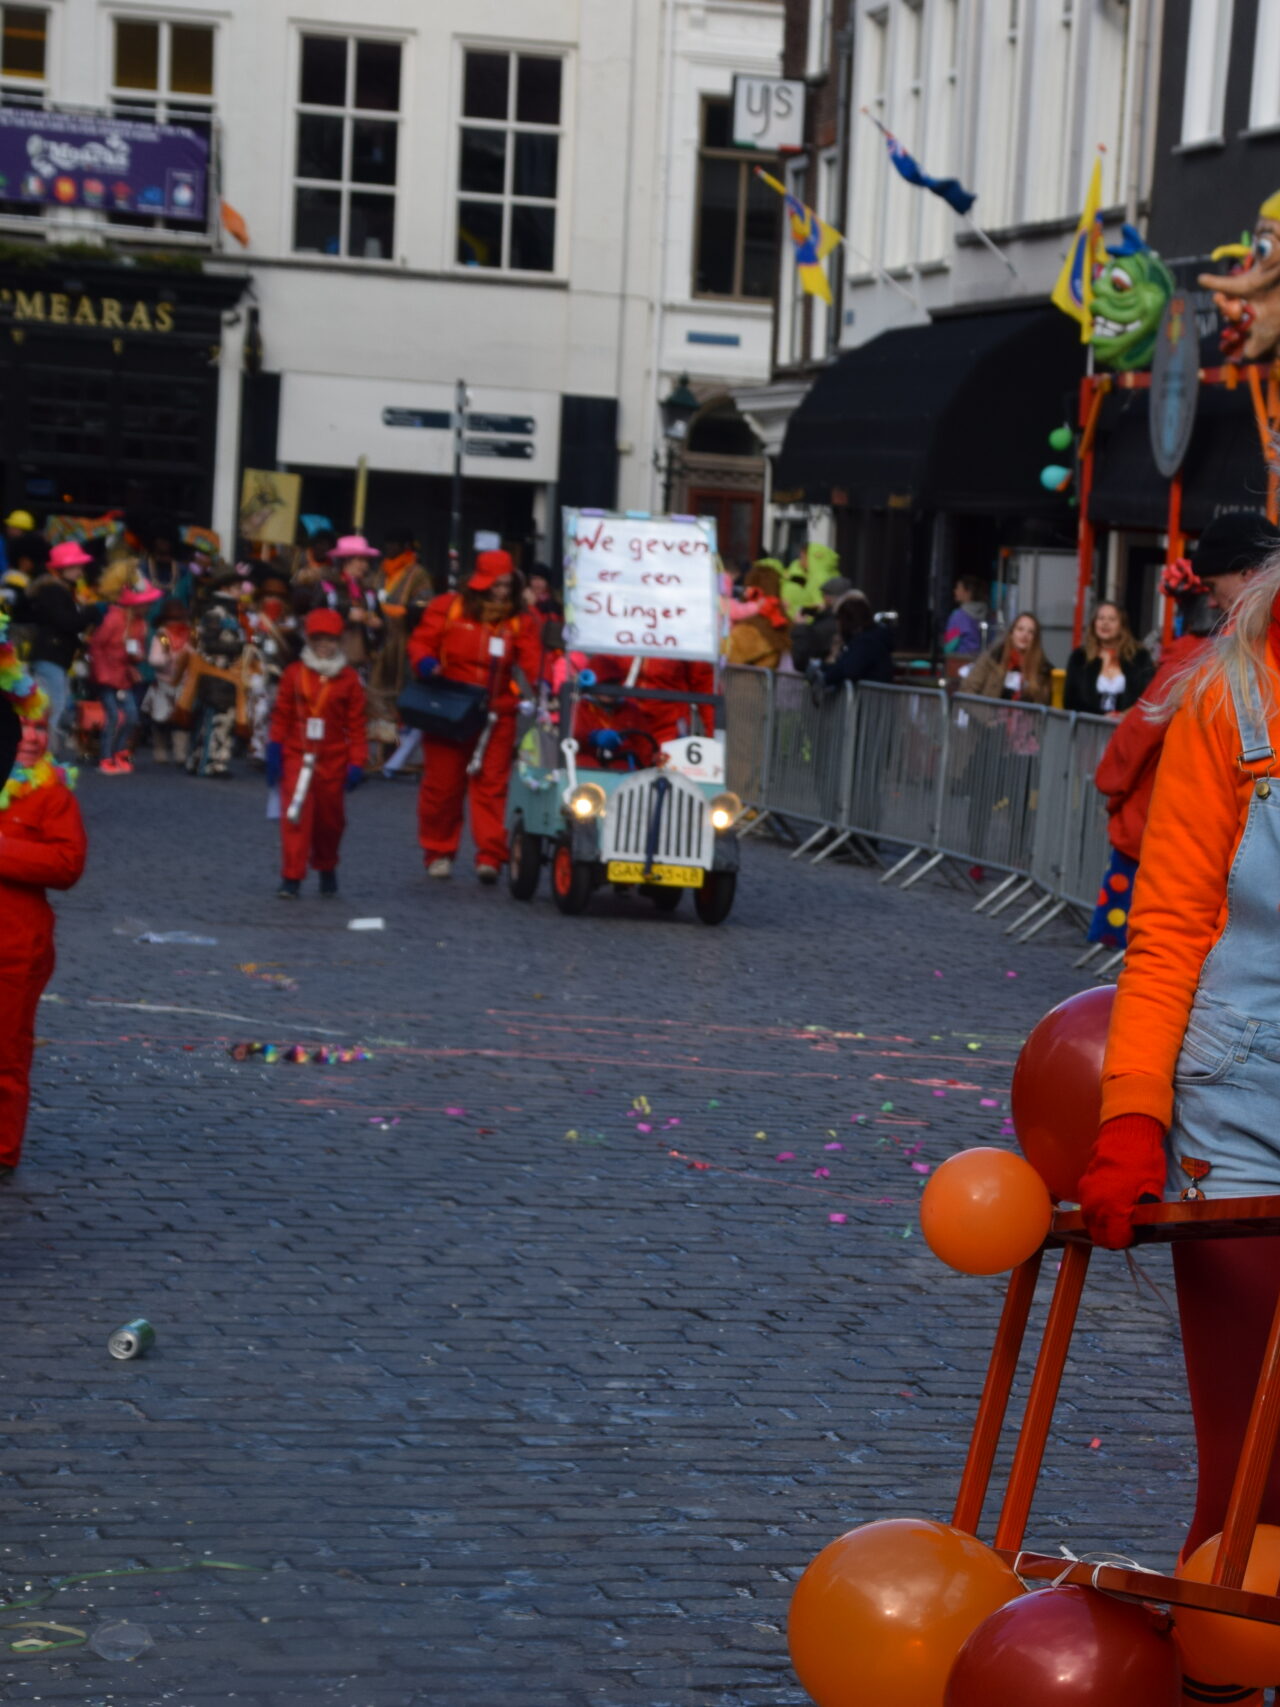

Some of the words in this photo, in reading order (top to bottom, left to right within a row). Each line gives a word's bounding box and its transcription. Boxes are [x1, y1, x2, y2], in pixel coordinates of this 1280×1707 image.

[0, 288, 176, 332] 'MEARAS
[574, 524, 614, 552] We
[629, 538, 709, 561] geven
[598, 569, 622, 582] er
[641, 571, 682, 585] een
[616, 631, 678, 647] aan
[686, 742, 702, 765] 6
